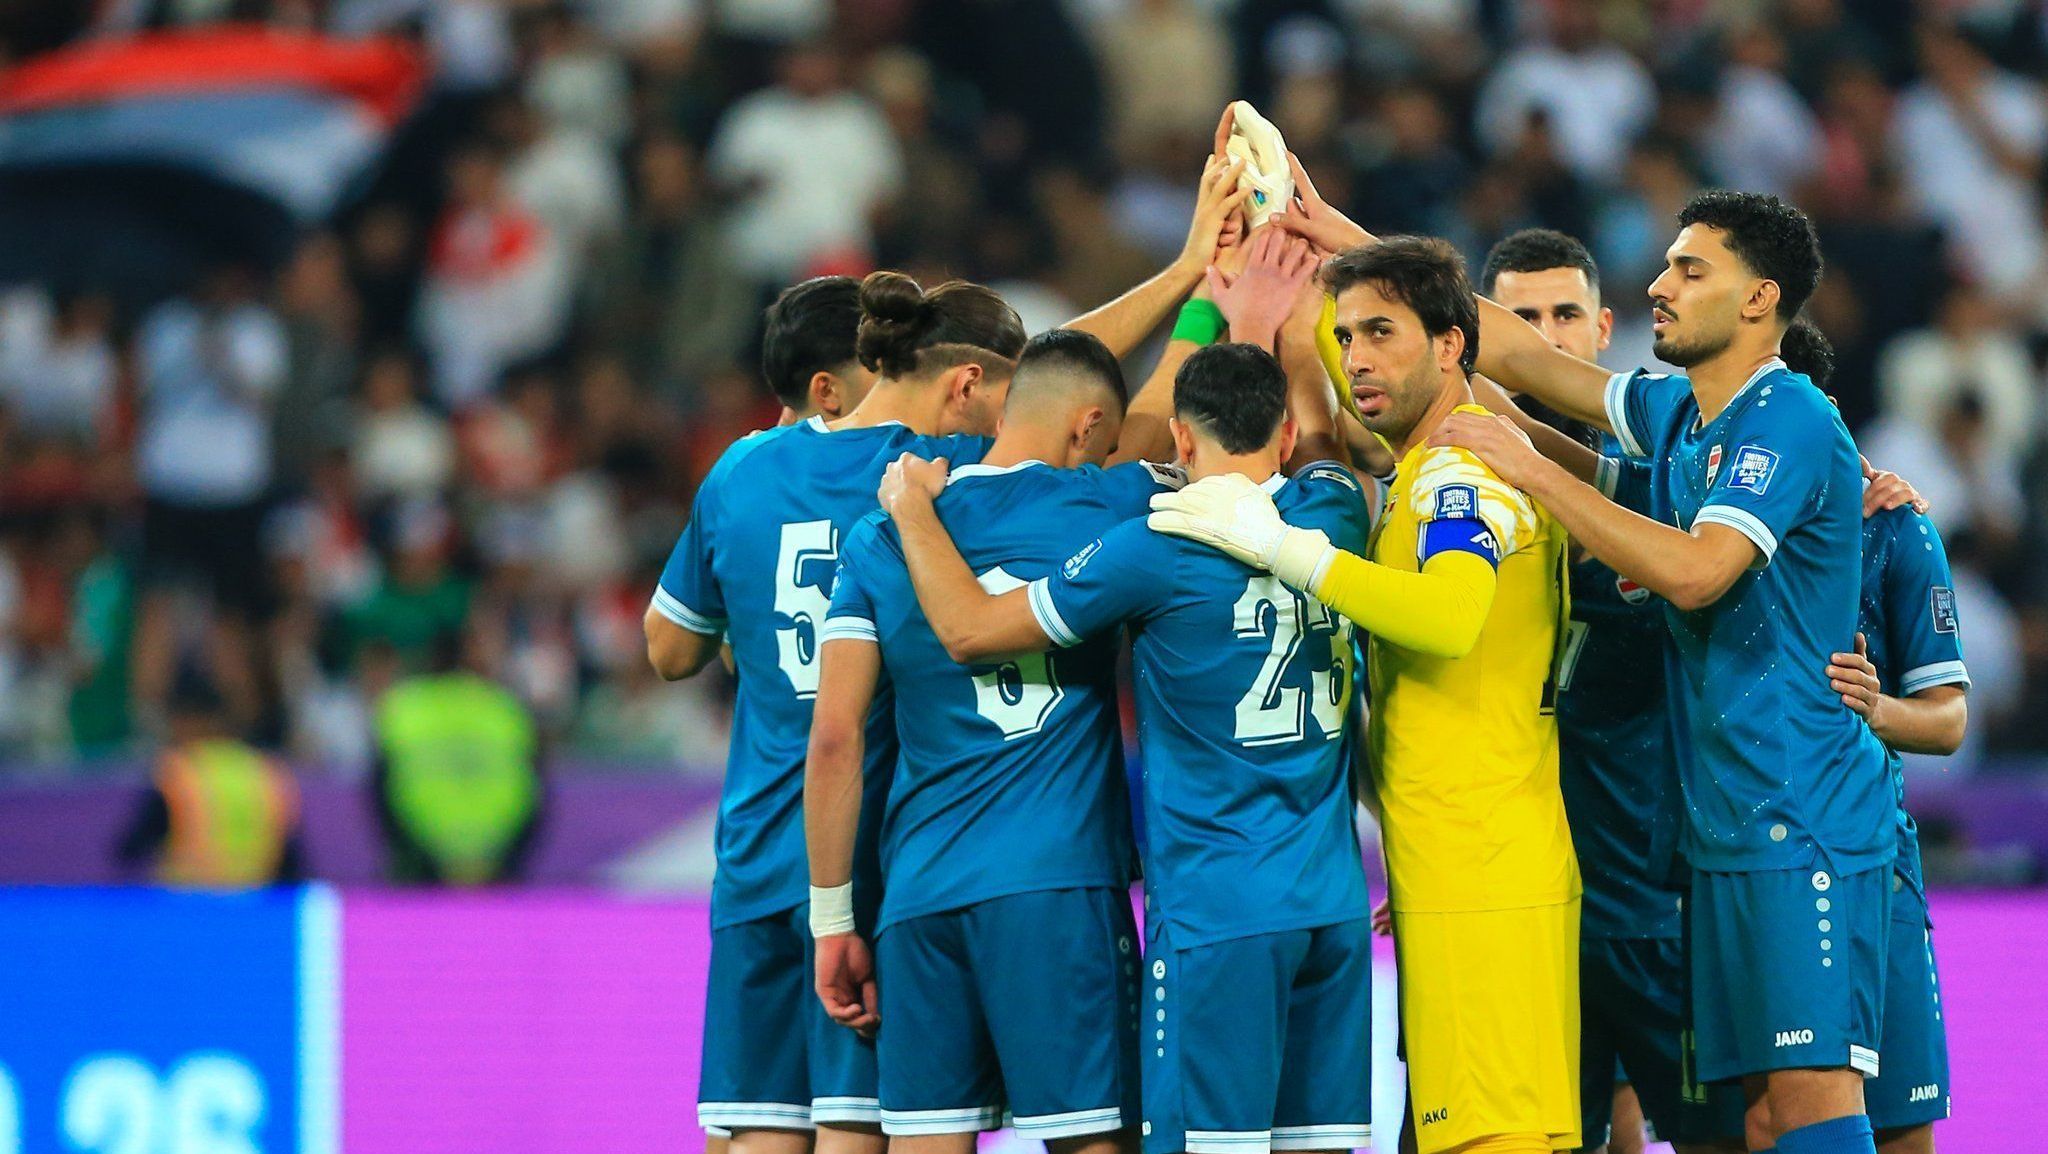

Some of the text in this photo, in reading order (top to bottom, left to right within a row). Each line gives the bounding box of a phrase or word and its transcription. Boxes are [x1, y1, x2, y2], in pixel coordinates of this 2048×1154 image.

[774, 518, 839, 700] 5
[1774, 1028, 1814, 1048] JAKO
[1909, 1083, 1939, 1103] JAKO
